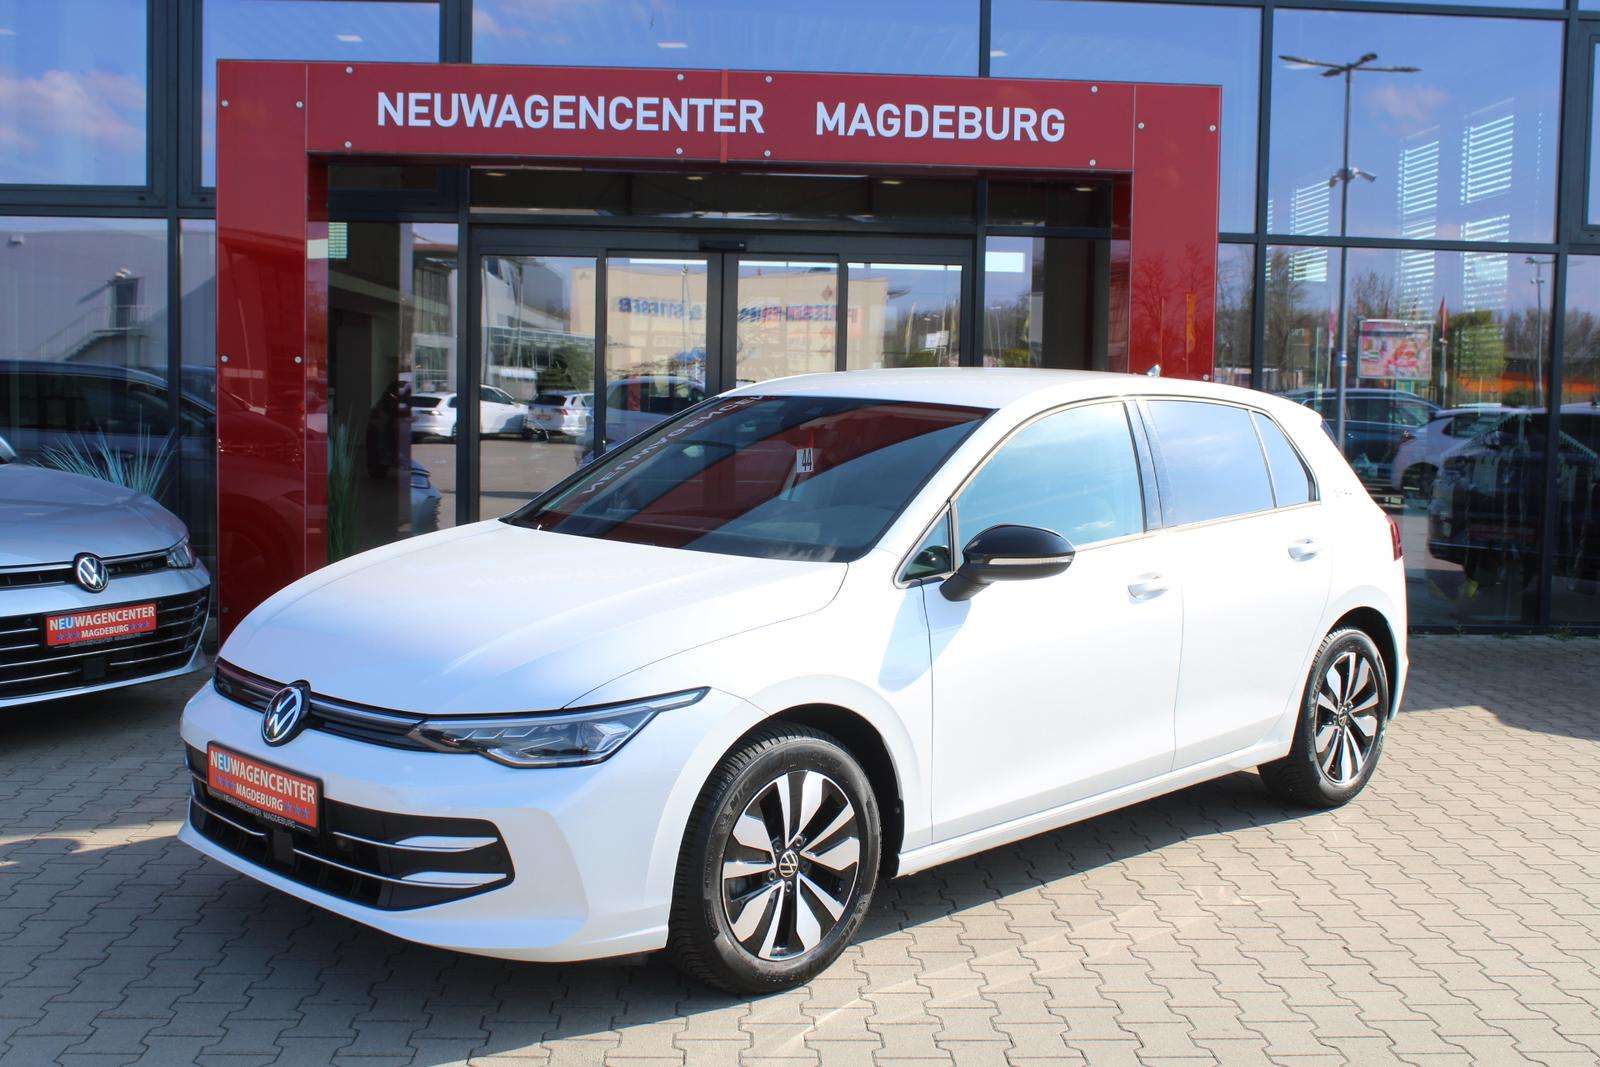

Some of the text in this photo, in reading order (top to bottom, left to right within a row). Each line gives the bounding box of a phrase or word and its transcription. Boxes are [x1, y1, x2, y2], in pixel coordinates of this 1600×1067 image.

[376, 91, 1066, 143] NEUWAGENCENTER MAGDEBURG
[801, 449, 813, 471] 44
[49, 606, 155, 631] NEUWAGENCENTER
[81, 624, 129, 639] MAGDEBURG
[210, 750, 315, 805] NEUWAGENCENTER
[235, 783, 284, 812] MAGDEBURG
